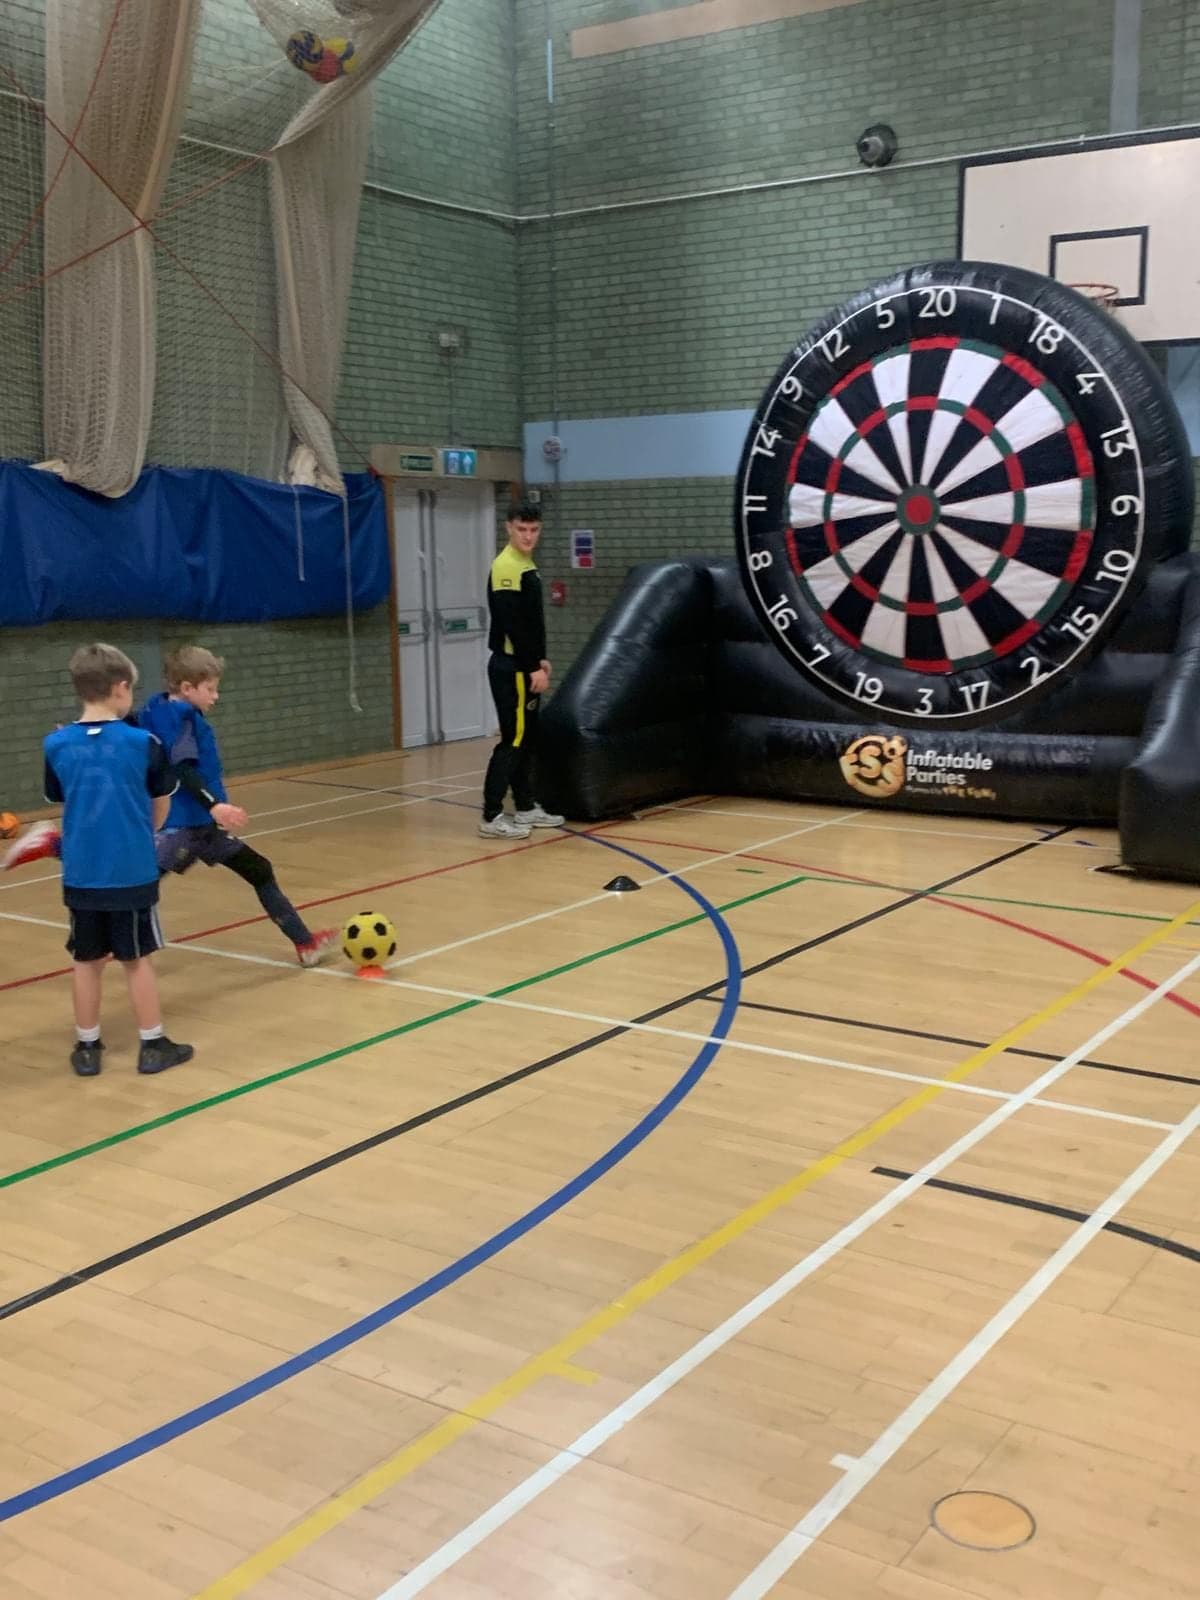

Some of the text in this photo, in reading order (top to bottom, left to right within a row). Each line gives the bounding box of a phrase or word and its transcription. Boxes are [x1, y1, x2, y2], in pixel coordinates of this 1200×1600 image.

[875, 299, 896, 330] 5
[918, 289, 957, 318] 20
[987, 294, 1002, 326] 1
[817, 331, 851, 363] 12
[1026, 314, 1065, 356] 18
[1073, 371, 1105, 396] 4
[752, 426, 782, 459] 14
[1099, 420, 1136, 459] 13
[743, 494, 768, 515] 11
[749, 550, 773, 572] 8
[1095, 548, 1136, 585] 10
[768, 595, 799, 633] 16
[1060, 606, 1100, 644] 15
[807, 643, 832, 668] 7
[853, 671, 884, 702] 19
[1019, 656, 1048, 687] 2
[913, 688, 933, 715] 3
[959, 681, 991, 712] 17
[906, 749, 993, 771] Inflatable
[906, 766, 967, 785] Parties
